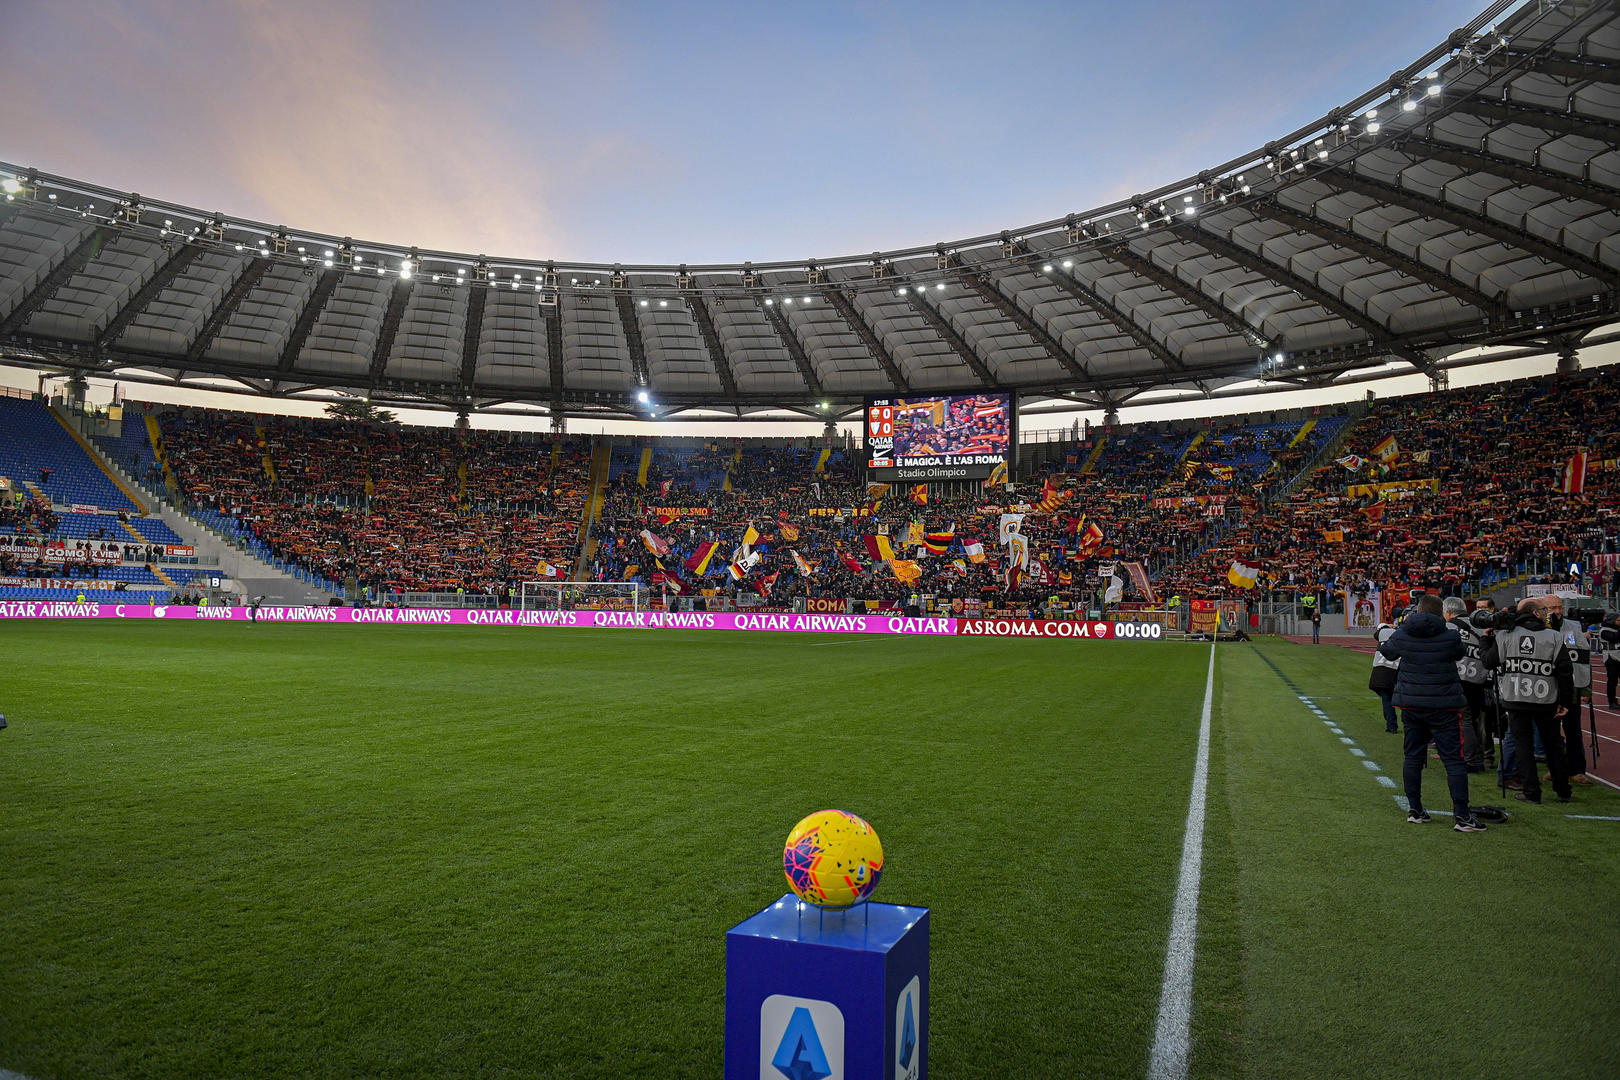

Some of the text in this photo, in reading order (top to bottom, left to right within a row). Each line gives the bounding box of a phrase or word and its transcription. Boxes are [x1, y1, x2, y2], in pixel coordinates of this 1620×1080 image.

[883, 408, 891, 419] 0
[883, 423, 891, 434] 0
[868, 437, 893, 446] QATAR
[904, 458, 944, 467] MAGICA.
[975, 455, 1004, 464] ROMA
[898, 468, 967, 479] Stadio Olimpico
[46, 548, 85, 557] COMO
[100, 551, 121, 559] VIEW
[211, 577, 220, 587] B
[39, 605, 100, 617] AIRWAYS
[807, 599, 846, 612] ROMA
[286, 606, 338, 621] AIRWAYS
[351, 608, 451, 623] QATAR AIRWAYS
[467, 610, 576, 625] QATAR AIRWAYS
[594, 611, 714, 628] QATAR AIRWAYS
[734, 613, 866, 631] QATAR AIRWAYS
[888, 616, 950, 634] QATAR
[962, 619, 1090, 637] ASROMA.COM
[1115, 622, 1161, 639] 00:00
[1505, 659, 1552, 676] PHOTO
[1510, 676, 1549, 699] 130
